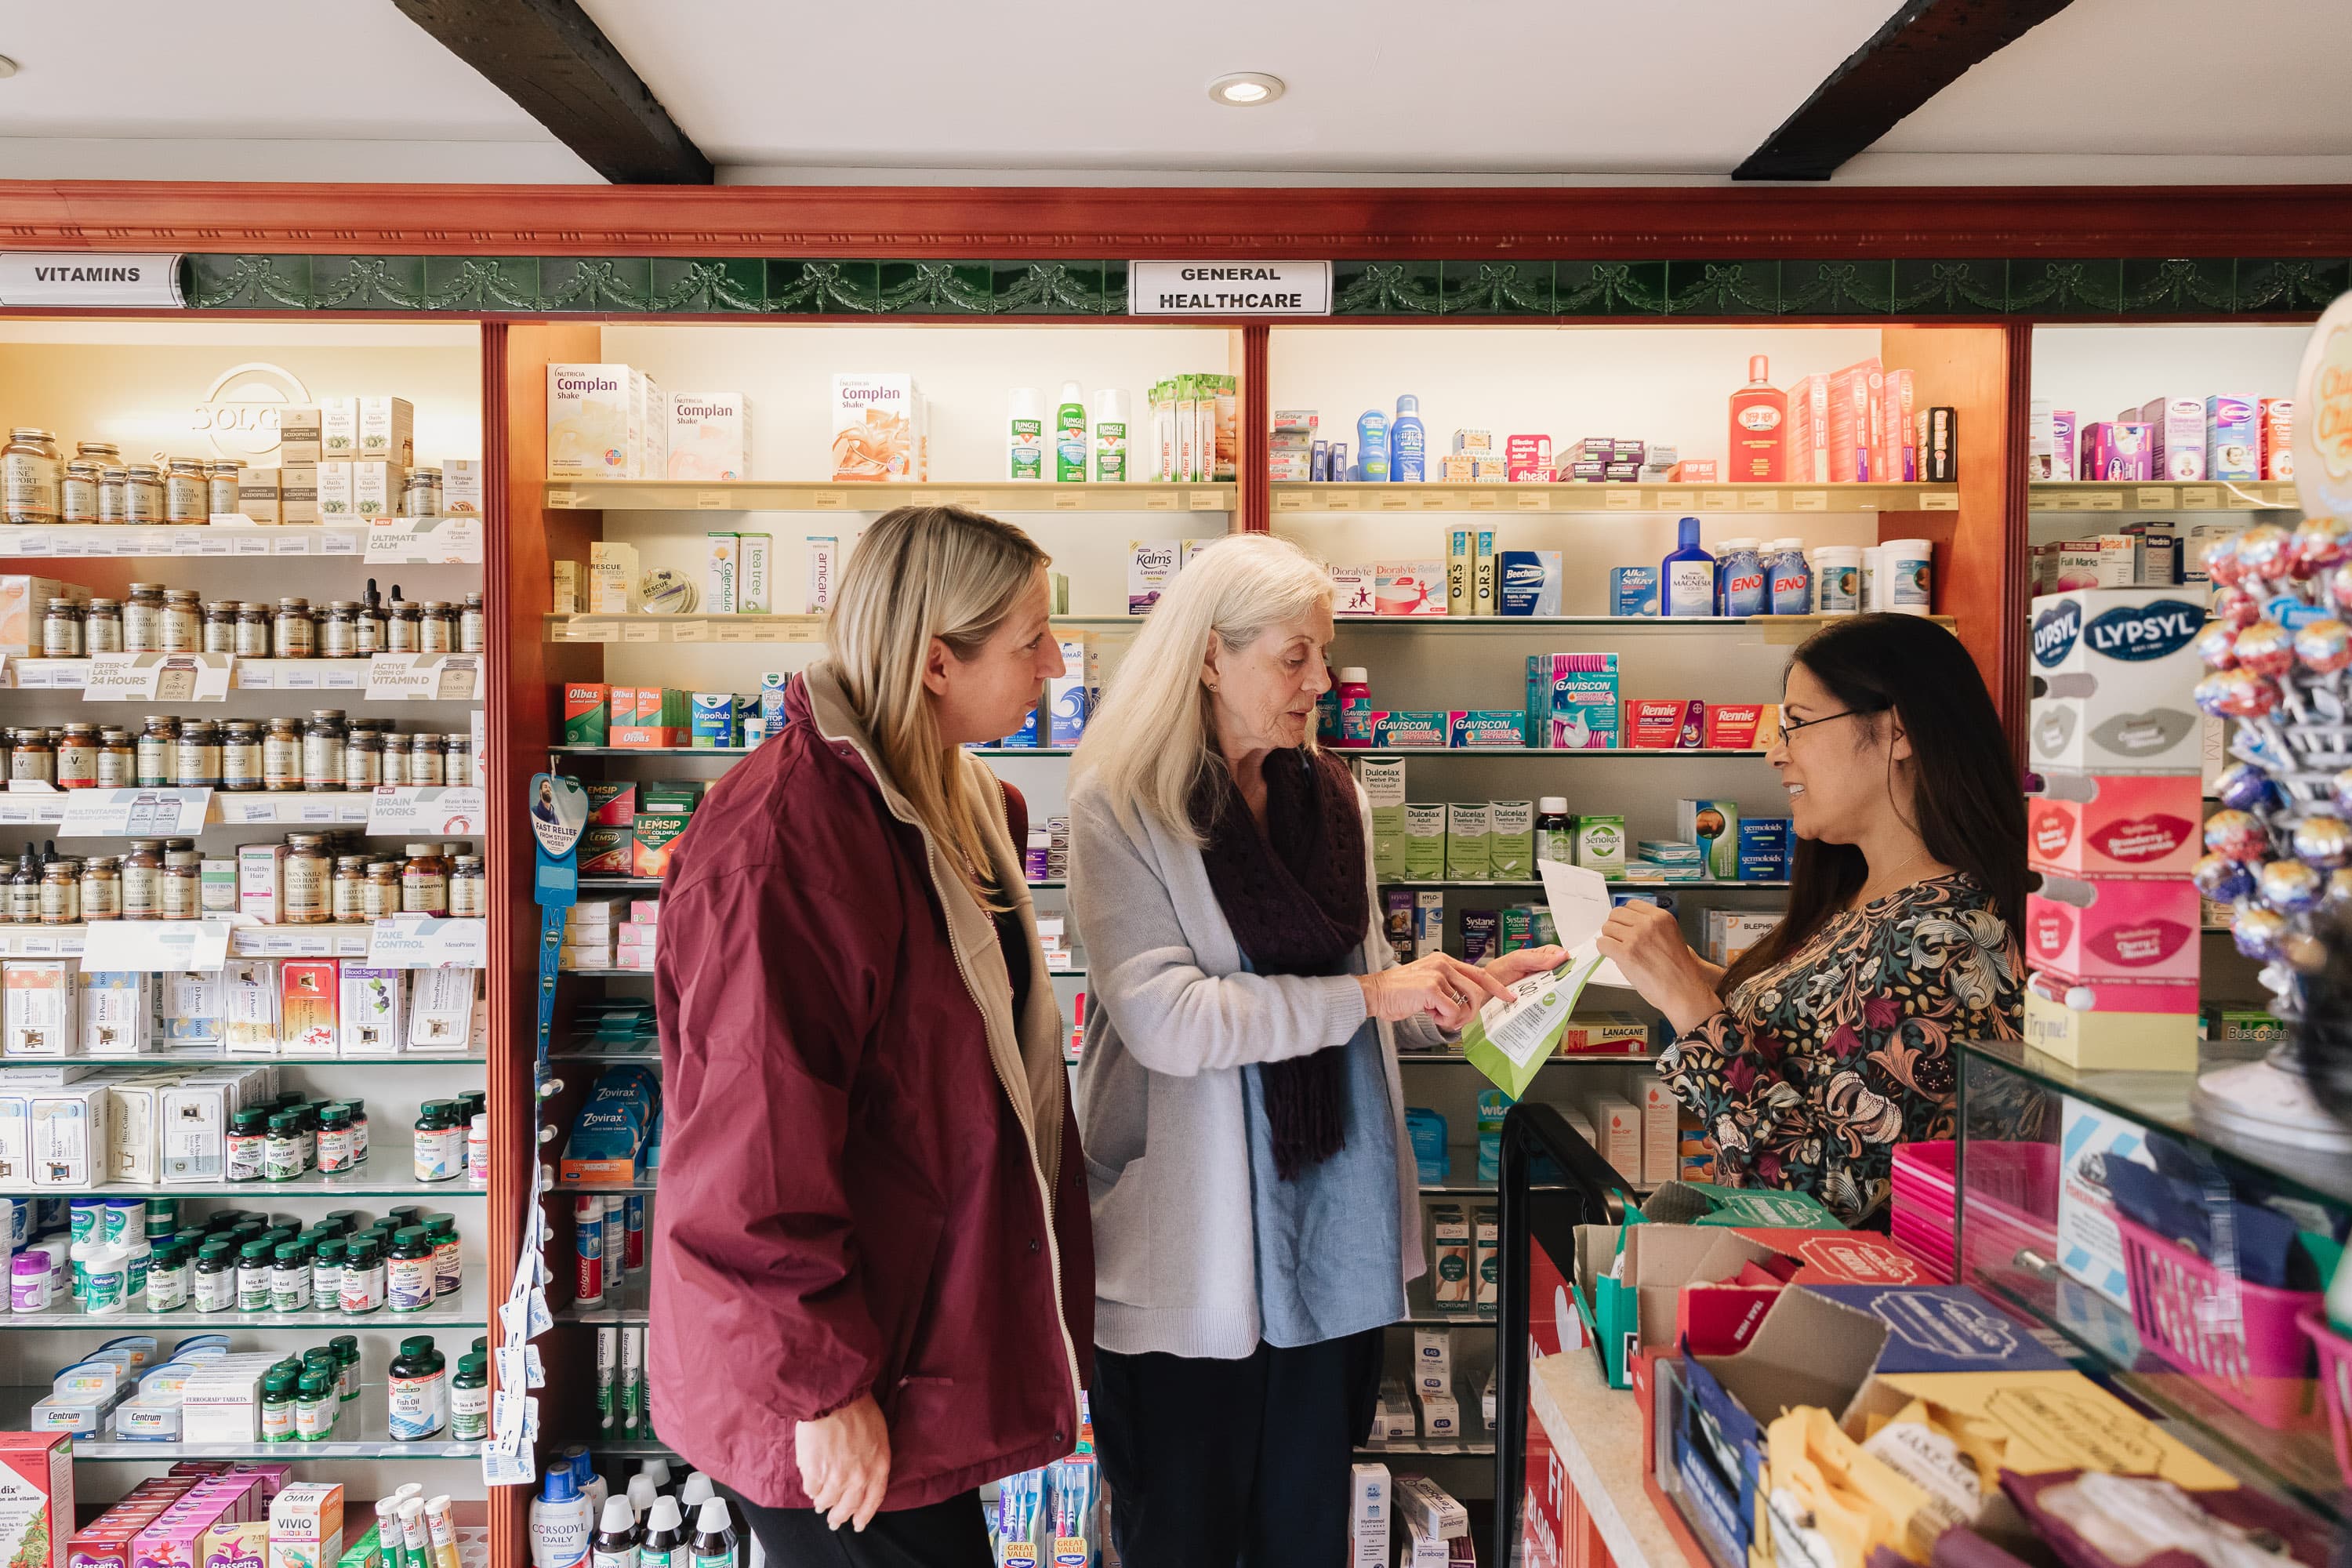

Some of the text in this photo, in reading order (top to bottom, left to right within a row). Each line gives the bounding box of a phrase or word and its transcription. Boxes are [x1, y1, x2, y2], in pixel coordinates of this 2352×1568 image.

[34, 267, 141, 282] VITAMINS
[1181, 267, 1281, 281] GENERAL
[1160, 293, 1302, 309] HEALTHCARE
[557, 378, 618, 393] Complan
[842, 387, 901, 401] Complan
[677, 404, 733, 419] Complan
[1015, 421, 1039, 430] JUNGLE
[1063, 416, 1085, 426] JUNGLE
[1100, 425, 1123, 434] JUNGLE
[1686, 464, 1714, 474] DEEP HEAT
[1517, 470, 1549, 481] 4head
[2148, 538, 2170, 546] Hedrin
[1136, 552, 1172, 566] Kalms
[2075, 557, 2099, 567] Marks
[753, 550, 762, 596] tea tree
[1332, 566, 1372, 577] Dioralyte
[1377, 564, 1442, 576] Dioralyte Relief
[1506, 568, 1542, 580] Beechams
[1622, 569, 1647, 578] Alka-
[818, 552, 828, 604] arnicare
[1452, 564, 1463, 599] O.R.S
[1479, 564, 1490, 599] O.R.S
[1621, 577, 1655, 586] Seltzer
[643, 580, 670, 595] RESCUE
[723, 562, 733, 612] Calendula
[1731, 576, 1762, 593] ENO
[1774, 576, 1806, 593] ENO
[2034, 612, 2078, 655] LYPSYL
[2095, 614, 2195, 648] LYPSYL
[106, 677, 147, 685] HOURS
[1555, 681, 1611, 691] GAVISCON
[569, 688, 598, 699] Olbas
[613, 691, 633, 699] Olbas
[639, 691, 659, 700] Olbas
[694, 710, 731, 721] VapoRub
[1641, 705, 1677, 717] Rennie
[1719, 710, 1755, 721] Rennie
[1377, 720, 1432, 730] GAVISCON
[1456, 720, 1510, 730] GAVISCON
[375, 808, 417, 817] WORKS
[1494, 809, 1527, 818] Dulcolax
[536, 822, 577, 836] FAST RELIEF
[637, 820, 681, 829] LEMSIP
[1744, 824, 1783, 833] germoloids
[590, 833, 619, 841] LEMSIP
[1585, 835, 1621, 845] Senokot
[1741, 855, 1781, 864] germoloids
[1465, 916, 1496, 929] Systane
[1505, 916, 1531, 927] Systane
[376, 931, 403, 940] TAKE
[375, 940, 425, 949] CONTROL
[1602, 1028, 1645, 1038] LANACANE
[2228, 1026, 2289, 1041] Buscopan
[596, 1087, 635, 1102] Zovirax
[583, 1112, 623, 1127] Zovirax
[93, 1276, 116, 1286] Valupak
[579, 1258, 589, 1298] Colgate
[397, 1398, 409, 1406] Fish
[48, 1411, 80, 1421] Centrum
[131, 1412, 162, 1422] Centrum
[1419, 1483, 1454, 1510] Zerobase
[278, 1519, 312, 1529] VIVIO
[532, 1523, 586, 1535] CORSODYL
[1439, 1519, 1464, 1528] Zerobase
[1417, 1550, 1445, 1559] Zerobase
